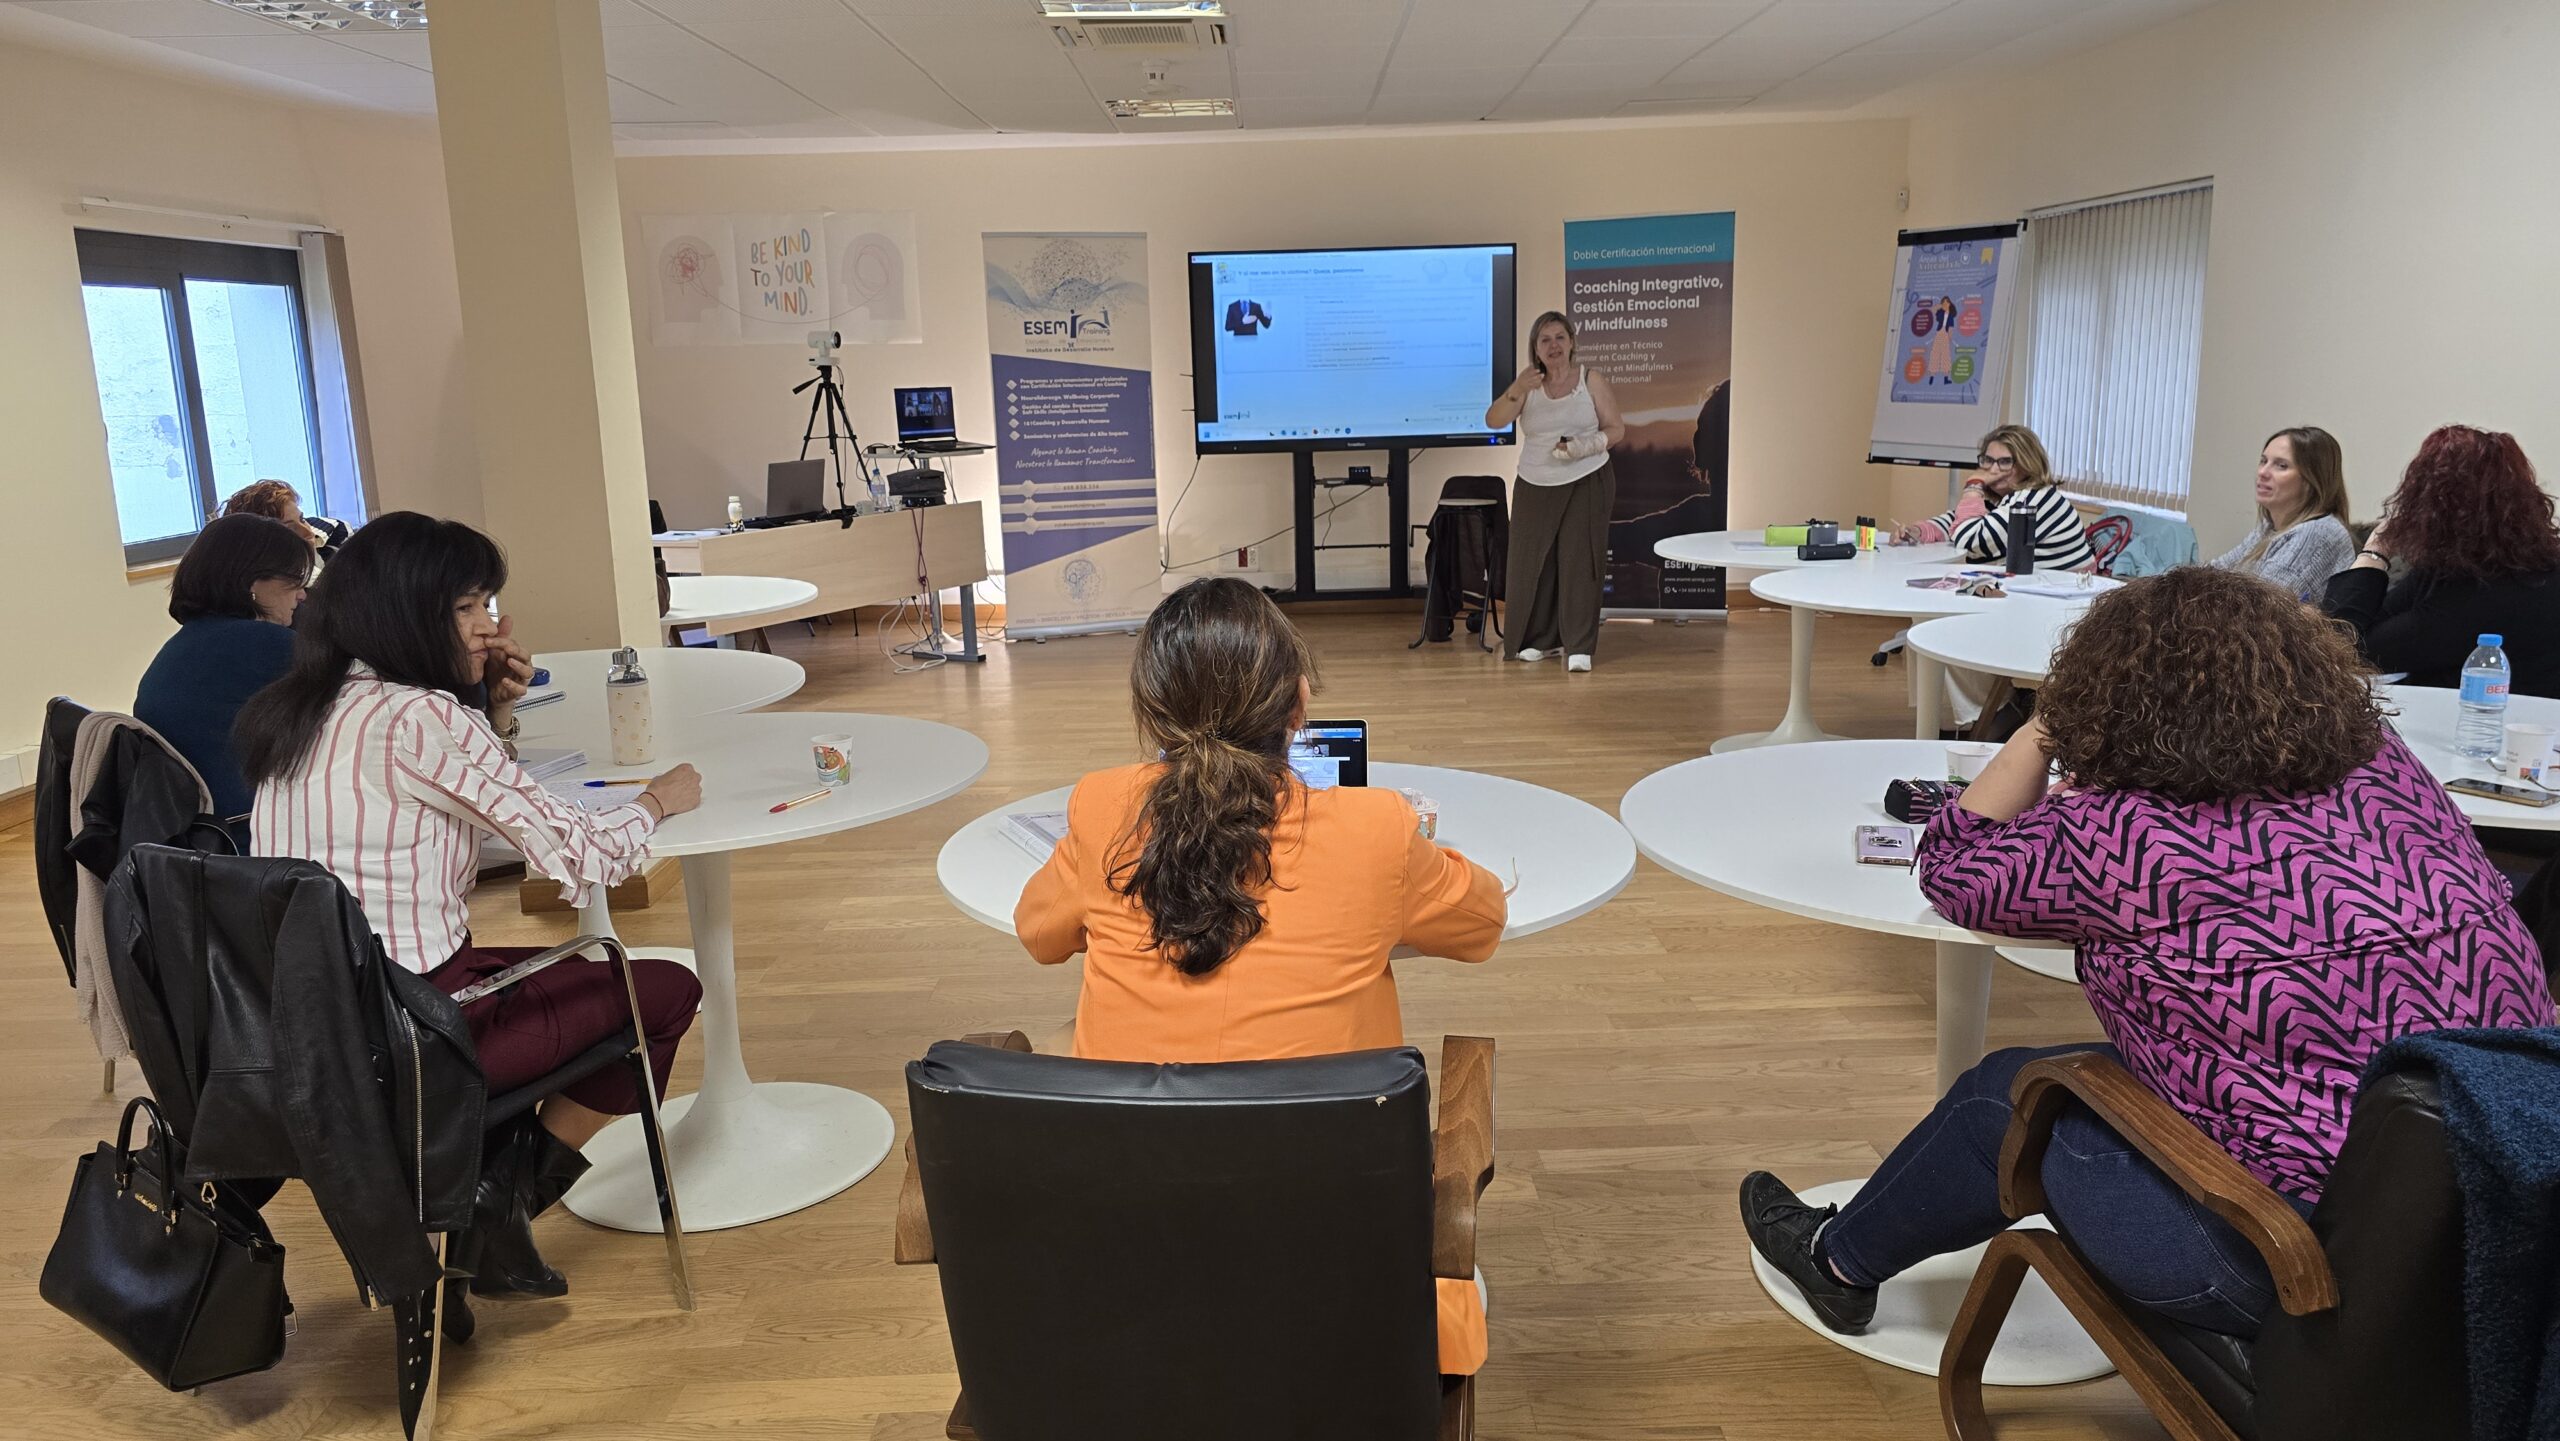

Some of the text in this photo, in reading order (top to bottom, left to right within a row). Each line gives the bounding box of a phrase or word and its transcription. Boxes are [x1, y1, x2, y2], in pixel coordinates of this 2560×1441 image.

[751, 228, 811, 264] BE KIND
[1574, 243, 1715, 260] Doble Certificación Internacional
[750, 260, 815, 288] TO YOUR
[1574, 276, 1723, 295] Coaching Integrativo,
[764, 286, 813, 316] MIND.
[1573, 296, 1700, 313] Gestión Emocional
[1574, 317, 1668, 335] y Mindfulness
[1632, 341, 1663, 350] Técnico
[1611, 353, 1648, 362] Coaching
[1650, 353, 1656, 361] y
[1626, 363, 1674, 372] Mindfulness
[1611, 375, 1652, 384] Emocional
[1015, 460, 1045, 469] Nosotros
